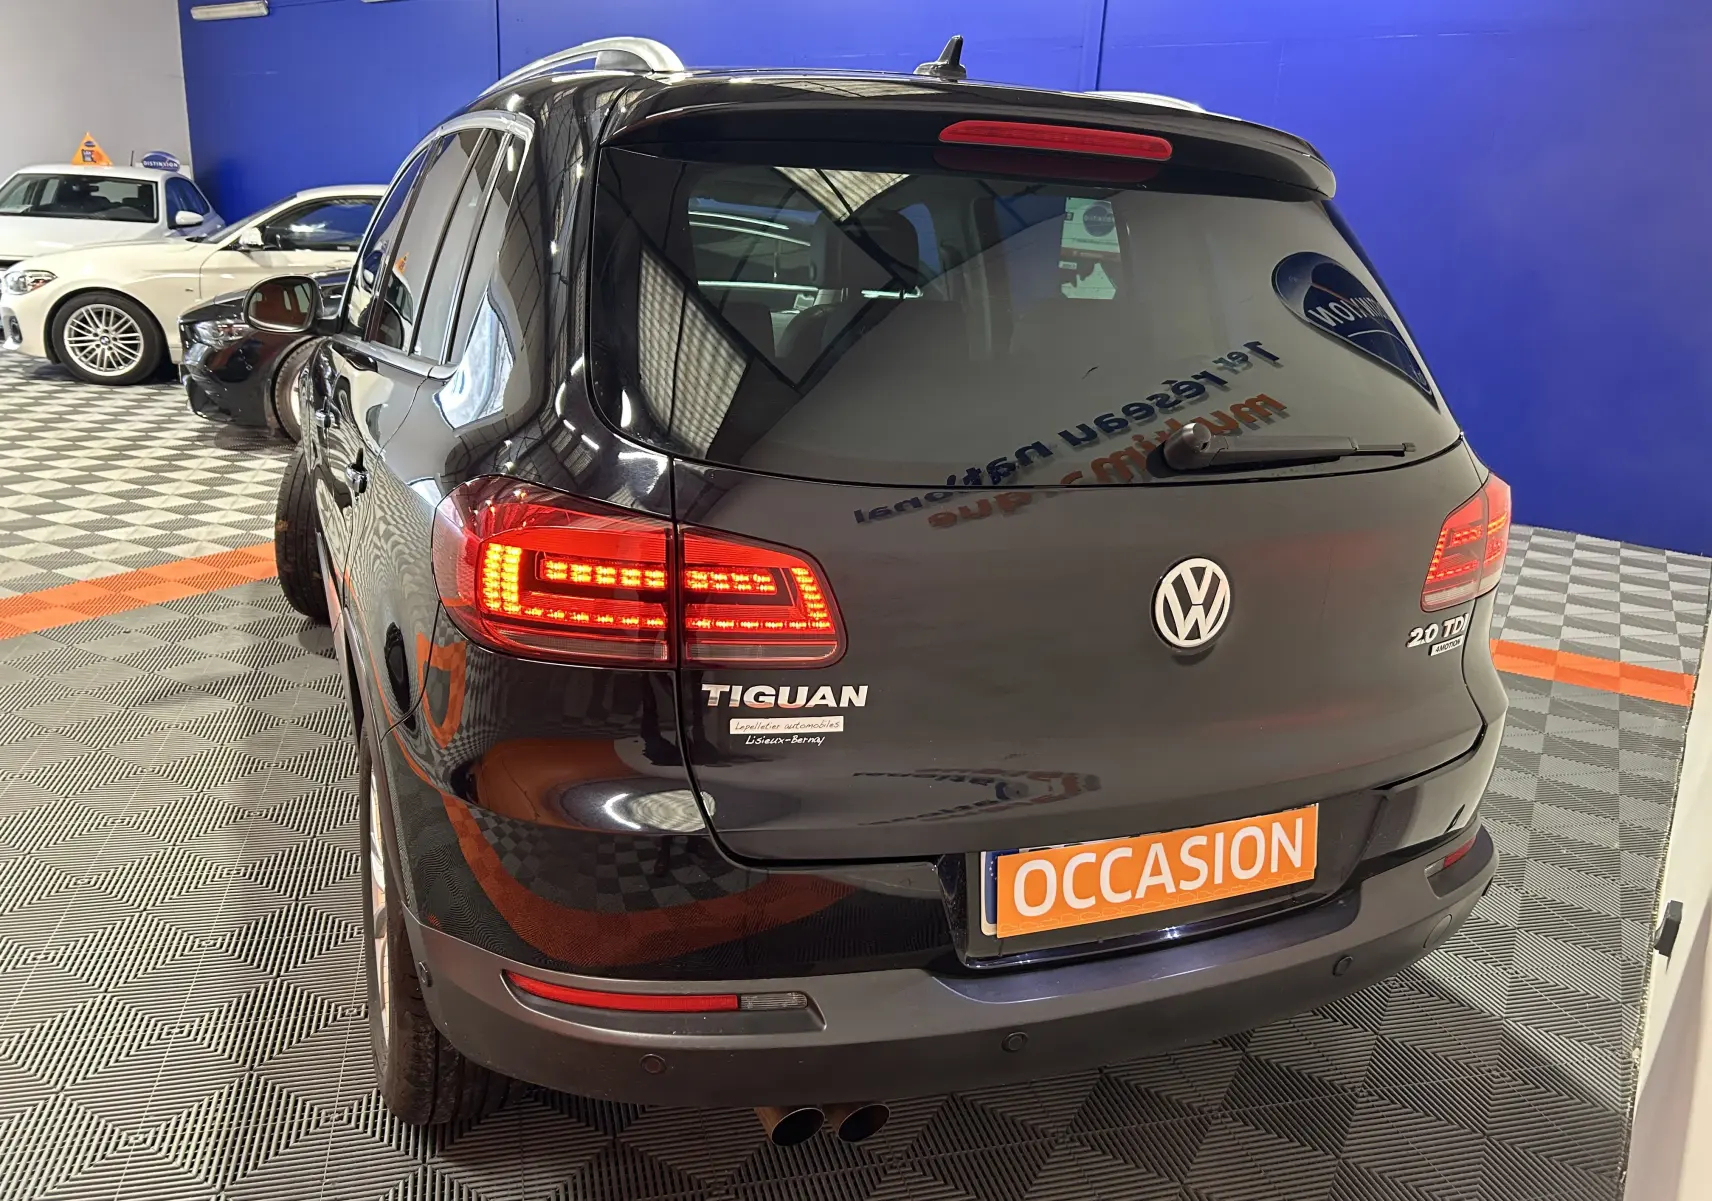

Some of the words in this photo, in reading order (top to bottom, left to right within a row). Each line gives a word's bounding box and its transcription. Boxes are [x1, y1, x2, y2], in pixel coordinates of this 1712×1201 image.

[1443, 613, 1469, 638] TDI
[1435, 639, 1461, 653] 4MOTION
[701, 684, 869, 709] TIGUAN
[735, 721, 781, 733] Lepelletier
[784, 719, 840, 731] automobiles
[745, 735, 826, 747] Lisieux-Bernay
[1013, 817, 1303, 918] OCCASION
